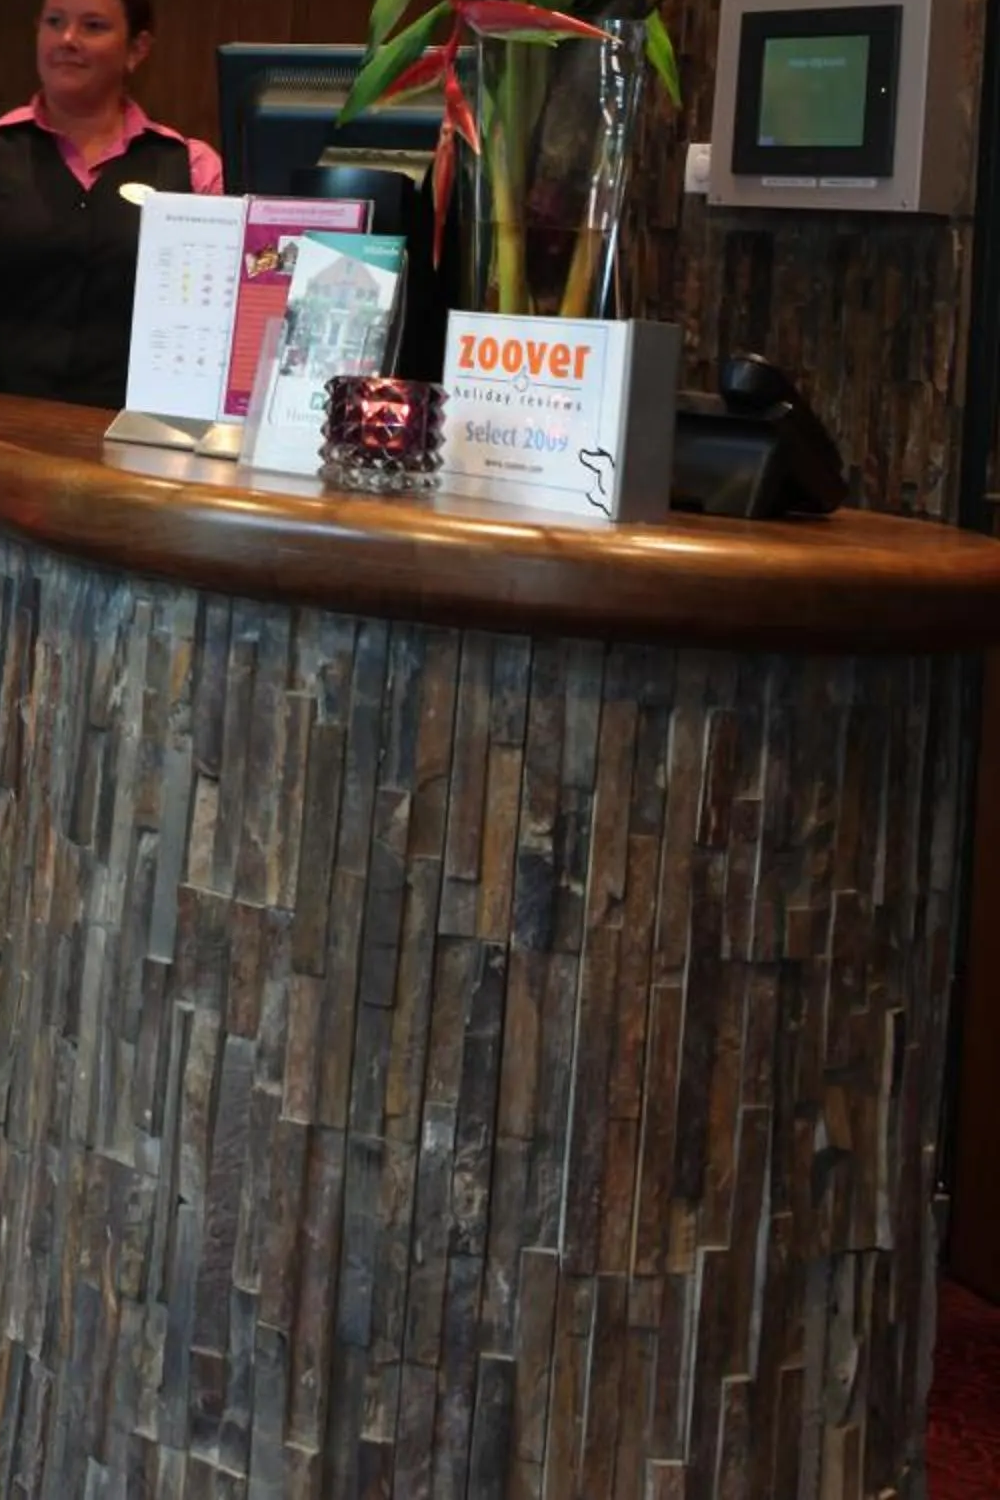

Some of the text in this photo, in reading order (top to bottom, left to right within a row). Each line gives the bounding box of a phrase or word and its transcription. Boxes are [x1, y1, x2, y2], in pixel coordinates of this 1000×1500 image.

[457, 335, 592, 380] zoover
[453, 387, 582, 412] holiday reviews
[465, 420, 517, 447] Select
